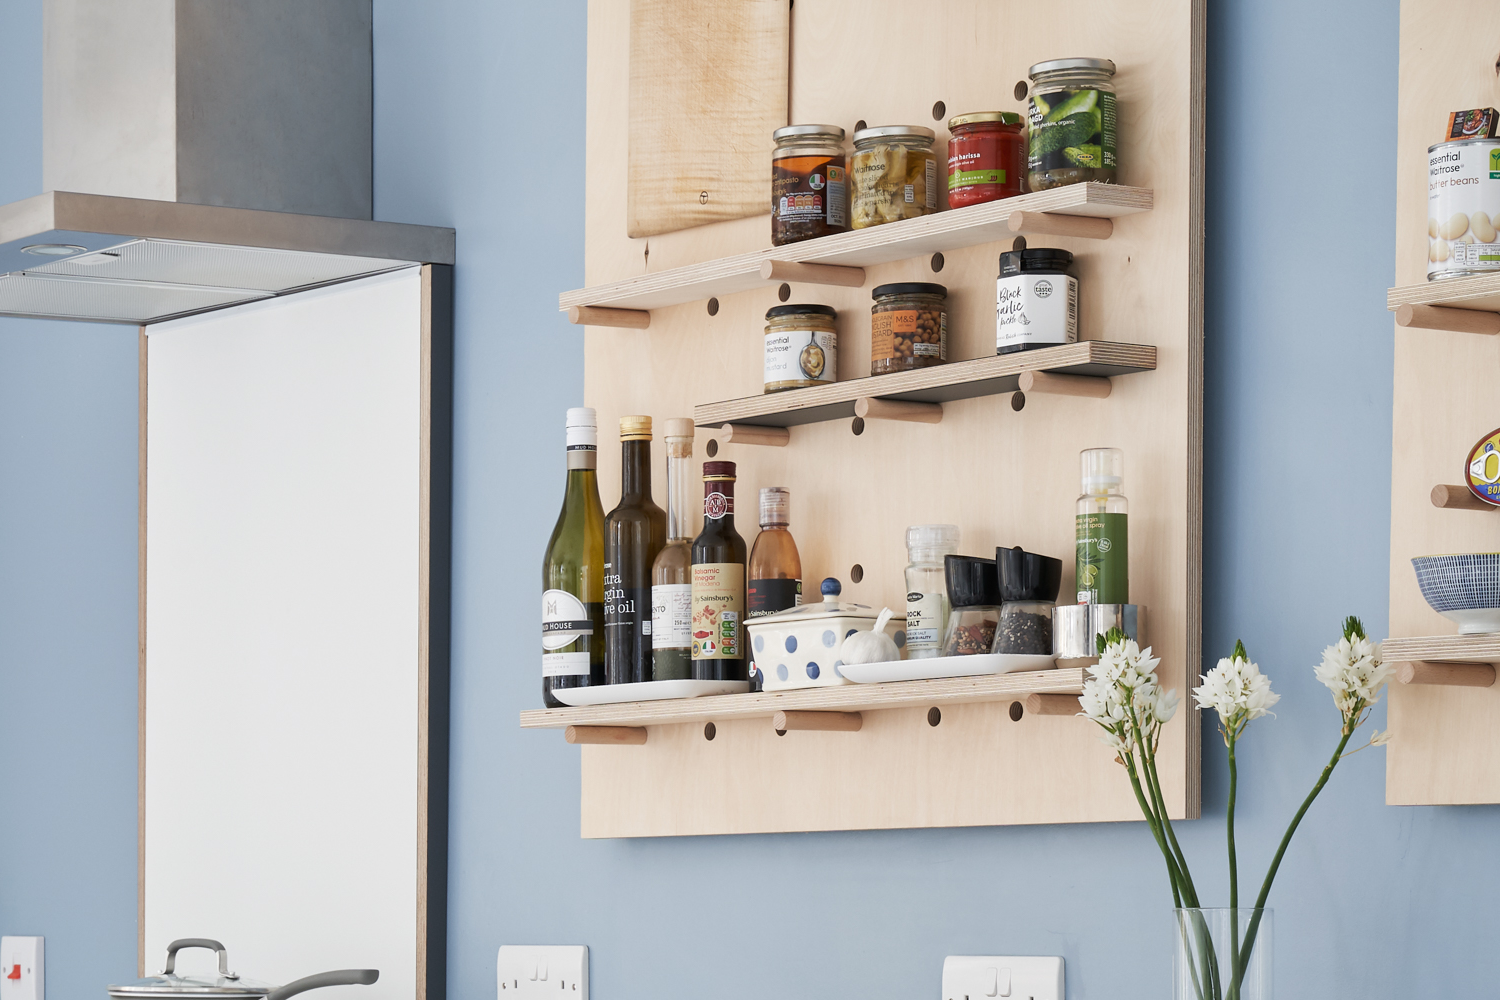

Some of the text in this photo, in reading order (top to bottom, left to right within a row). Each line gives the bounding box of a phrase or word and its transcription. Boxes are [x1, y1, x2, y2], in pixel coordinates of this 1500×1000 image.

[958, 152, 981, 160] harissa
[1430, 151, 1461, 166] essential
[854, 163, 886, 174] Waitrose
[1430, 165, 1460, 176] Waitrose
[1430, 177, 1479, 191] butter beans
[895, 315, 914, 323] M&S
[874, 321, 892, 330] LISH
[872, 328, 893, 339] STARD
[700, 594, 734, 603] Sainsbury's
[617, 600, 636, 614] oil
[750, 609, 780, 617] Sainsbury
[549, 622, 573, 630] HOUSE
[907, 620, 921, 628] SALT
